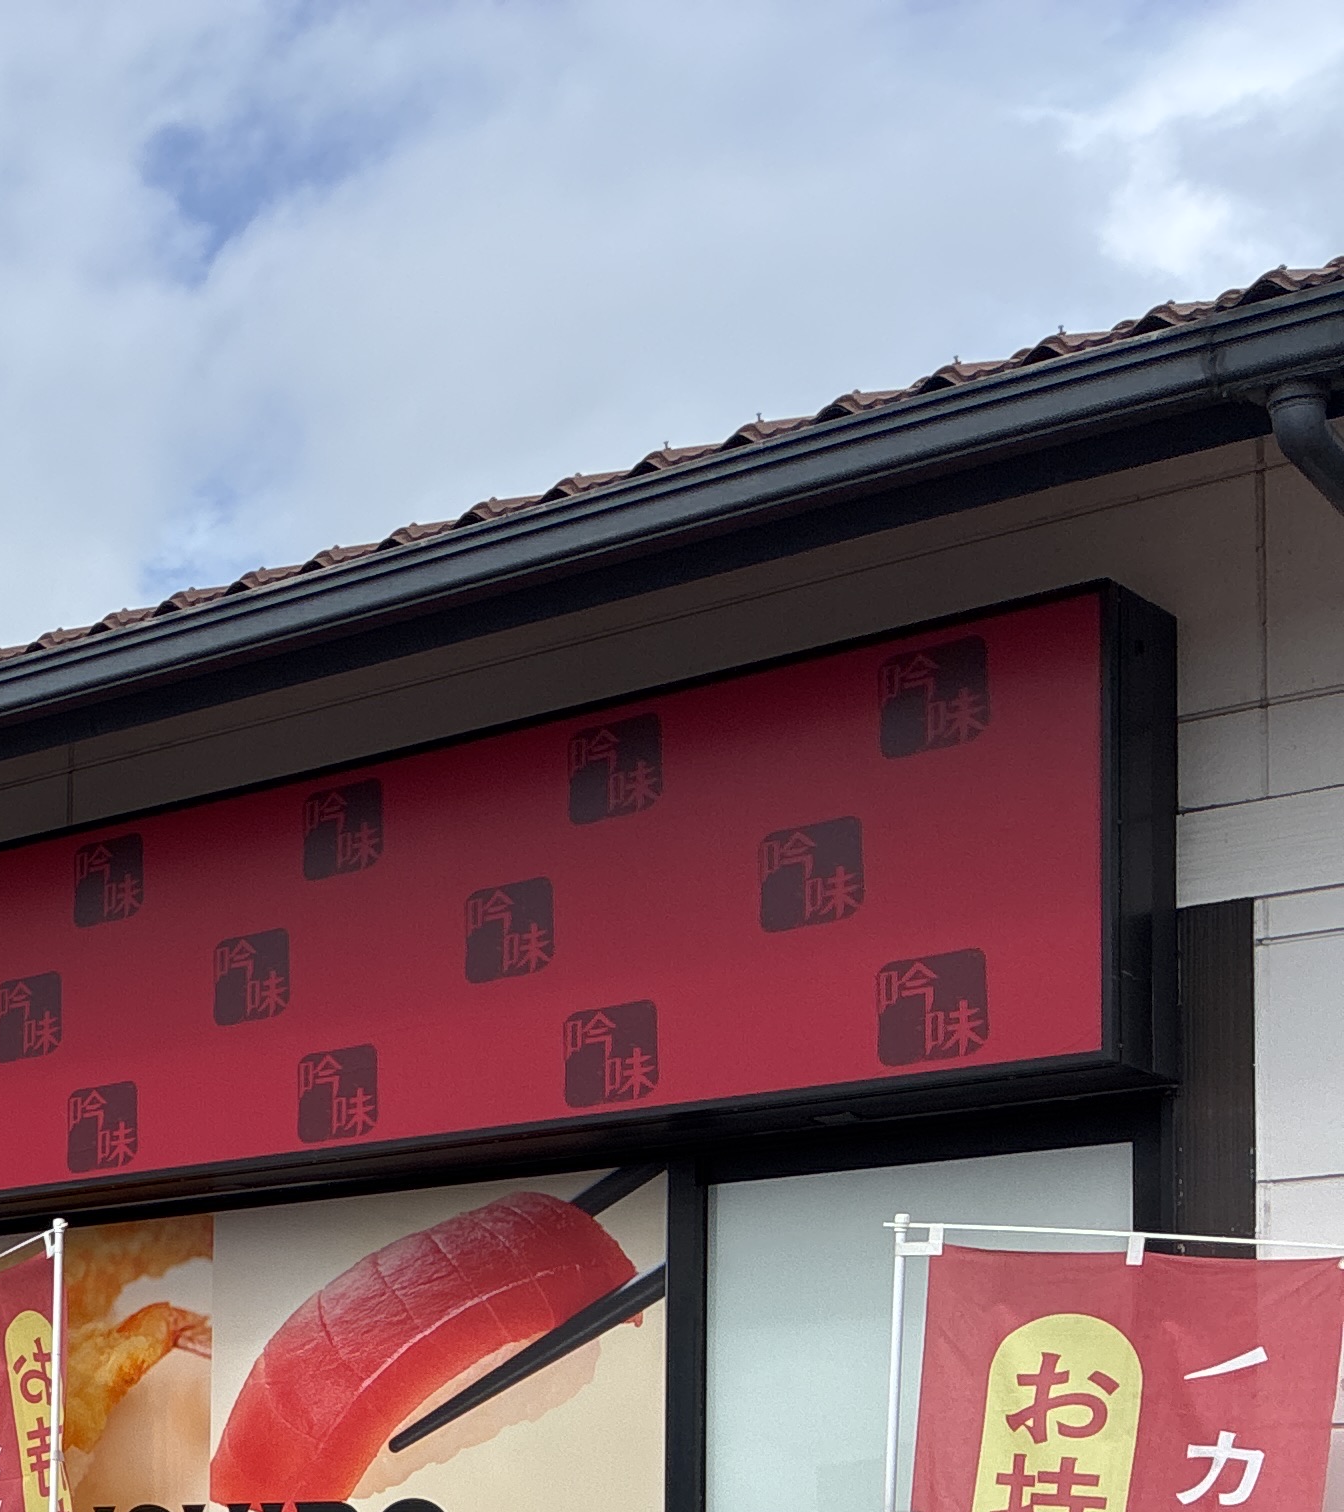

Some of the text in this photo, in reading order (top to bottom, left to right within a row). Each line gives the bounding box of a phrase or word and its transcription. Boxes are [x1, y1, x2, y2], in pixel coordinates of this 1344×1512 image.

[760, 832, 864, 920] 吟味
[466, 888, 554, 974] 吟味
[215, 940, 289, 1017] 吟味
[877, 962, 990, 1058] 吟味
[299, 1055, 376, 1136] 吟味
[565, 1011, 658, 1098] 吟味
[70, 1090, 137, 1168] 吟味
